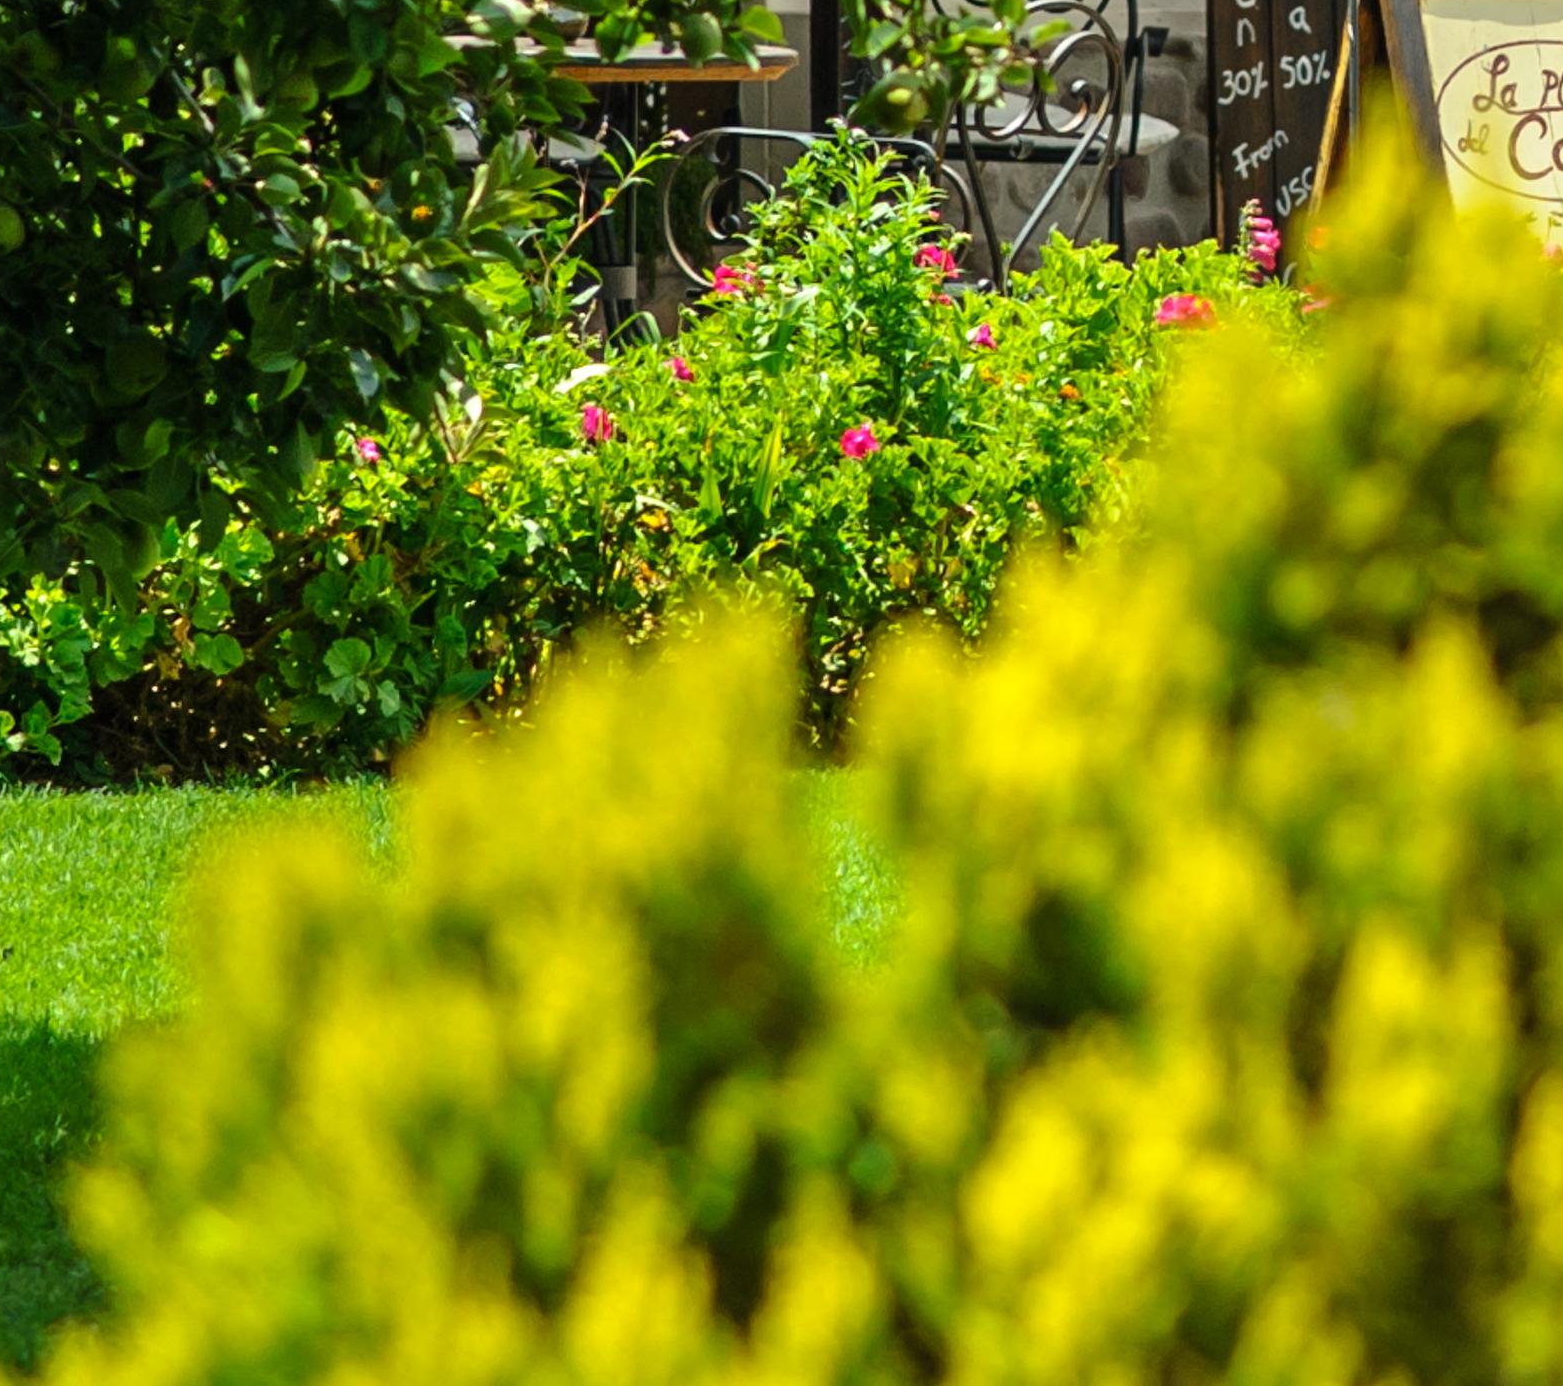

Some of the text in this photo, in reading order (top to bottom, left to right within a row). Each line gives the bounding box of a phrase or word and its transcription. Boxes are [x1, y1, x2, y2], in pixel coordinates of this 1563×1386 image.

[1217, 60, 1269, 106] 30%
[1279, 49, 1331, 89] 50%
[1473, 53, 1519, 115] La
[1458, 118, 1490, 156] del
